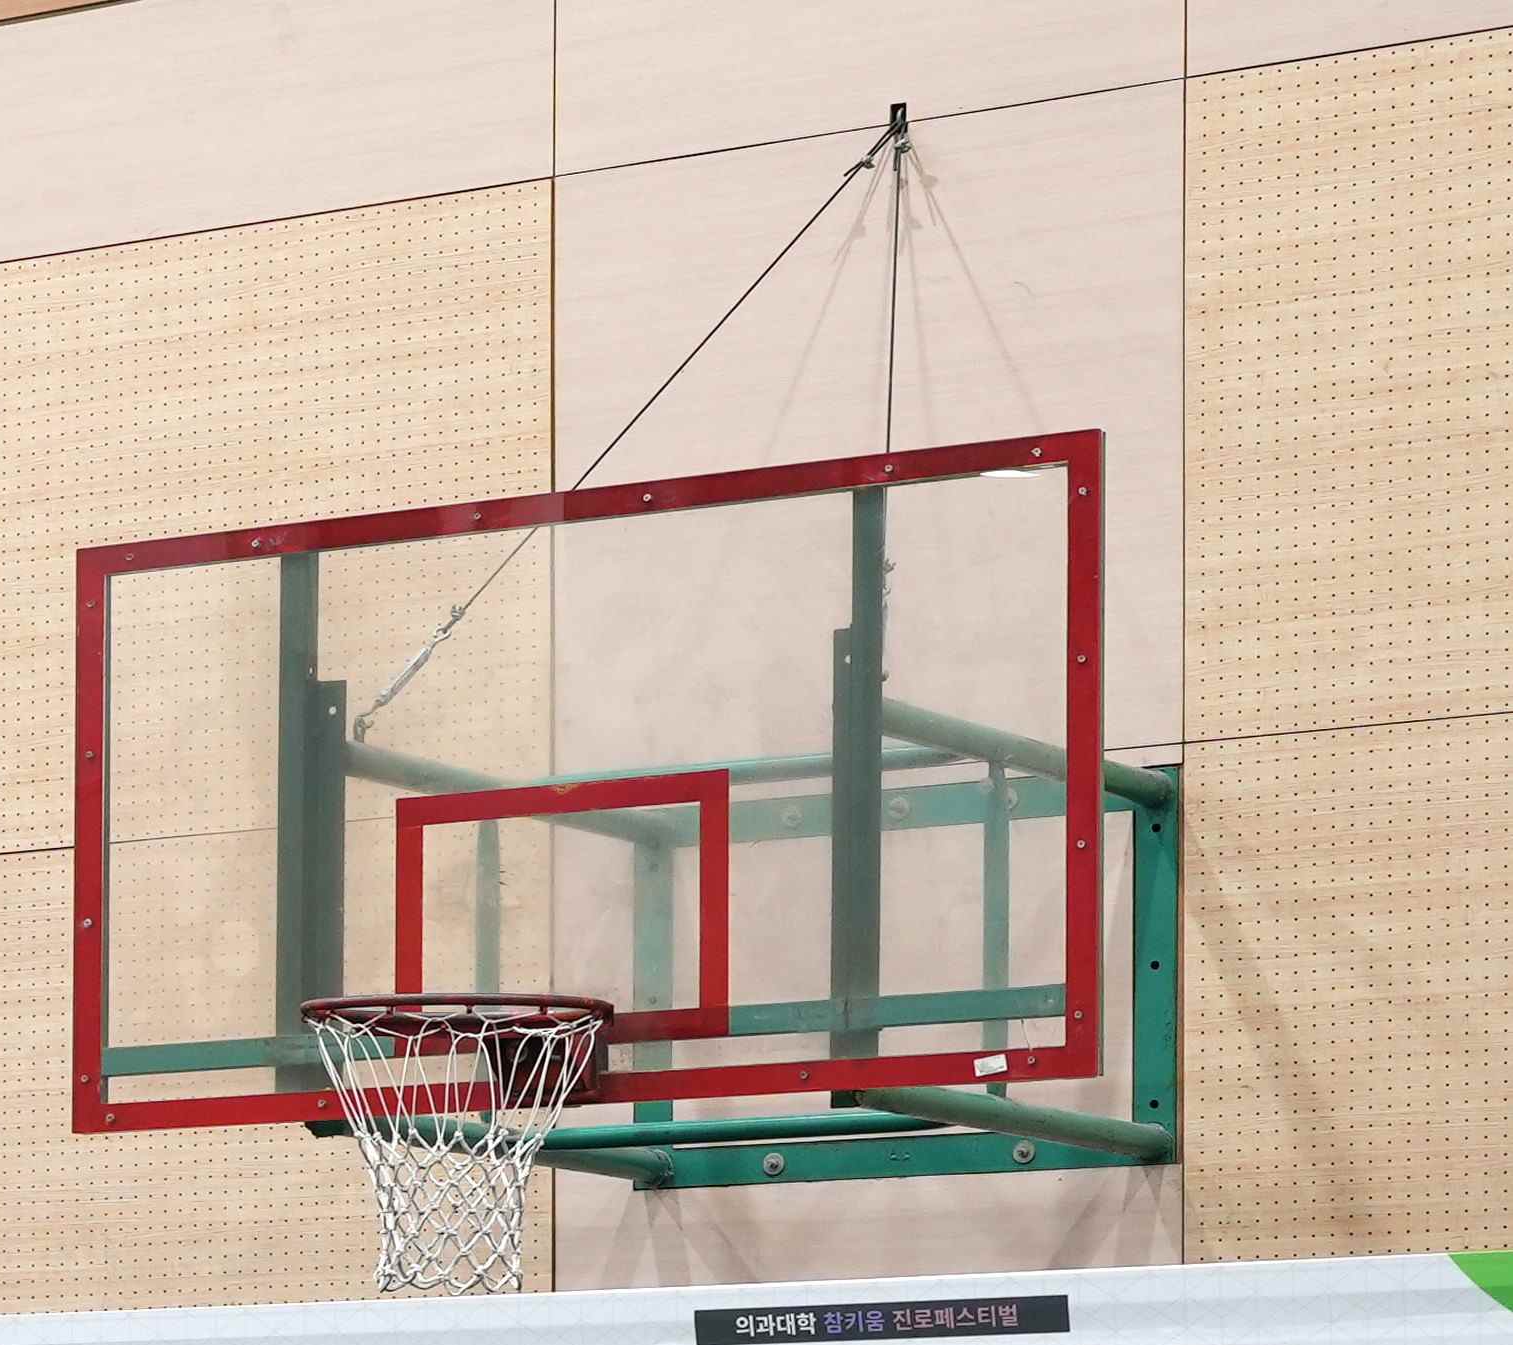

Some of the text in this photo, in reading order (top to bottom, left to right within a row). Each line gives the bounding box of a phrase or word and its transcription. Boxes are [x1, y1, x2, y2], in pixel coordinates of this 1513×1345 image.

[736, 1304, 1018, 1337] 의과대학 참키움 진로페스티벌
